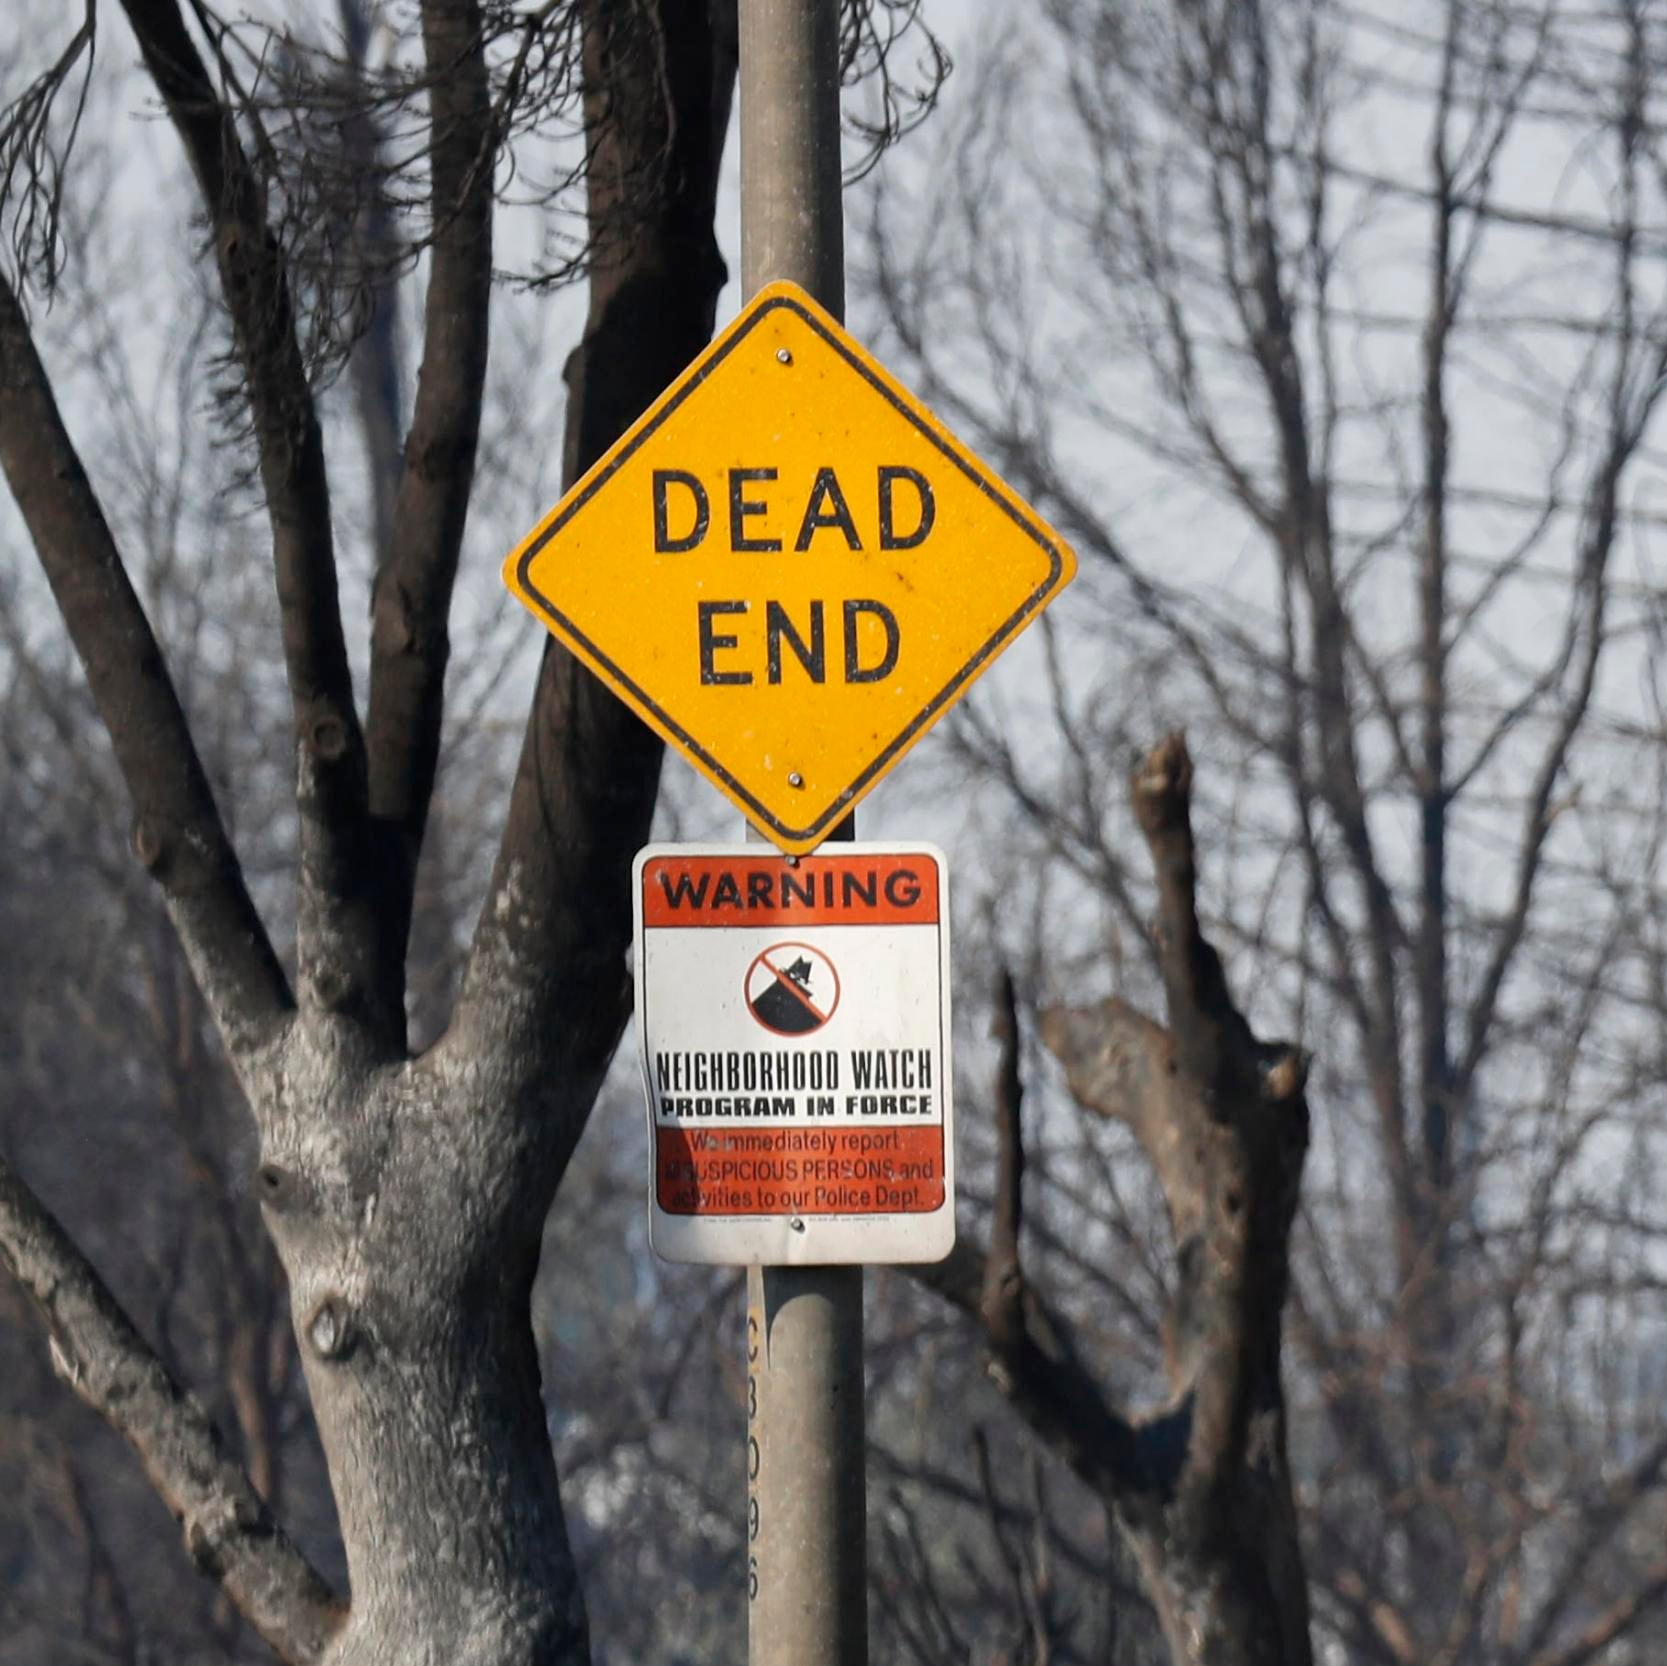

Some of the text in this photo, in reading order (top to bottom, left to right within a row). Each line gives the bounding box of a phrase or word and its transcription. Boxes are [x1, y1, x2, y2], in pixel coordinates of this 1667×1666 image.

[652, 466, 936, 553] DEAD
[696, 599, 901, 686] END
[659, 870, 922, 909] WARNING
[656, 1049, 932, 1091] NEIGHBORHOOD WATCH
[661, 1095, 932, 1117] PROGRAM IN FORCE
[722, 1130, 836, 1154] immediately
[841, 1131, 899, 1155] report
[802, 1158, 894, 1181] PERSONS
[901, 1159, 934, 1180] and
[757, 1187, 776, 1208] to
[780, 1190, 809, 1208] our
[815, 1186, 871, 1207] Police
